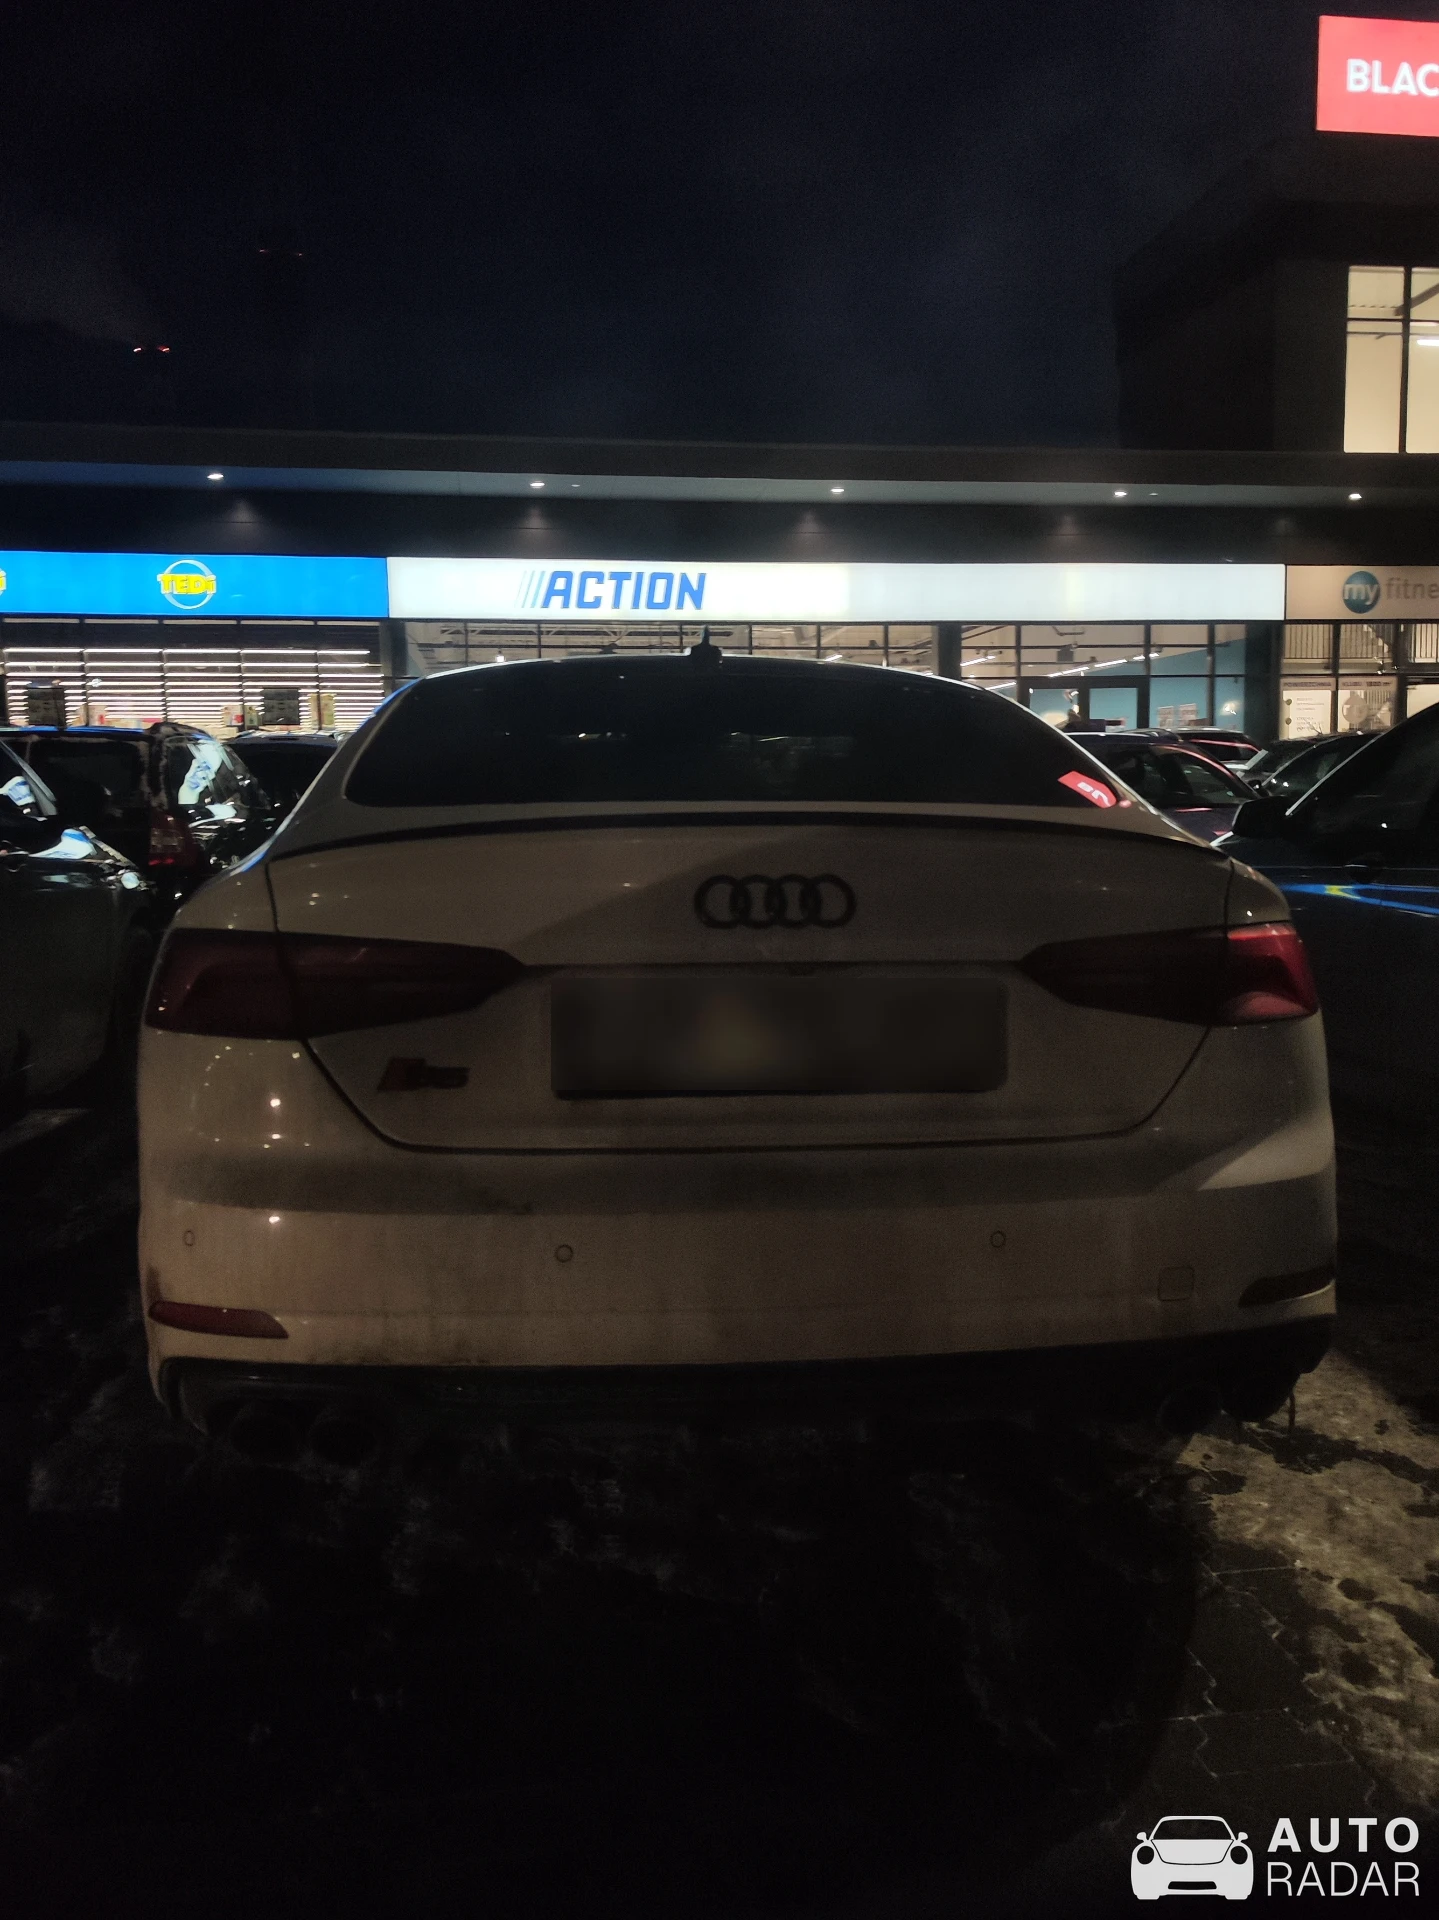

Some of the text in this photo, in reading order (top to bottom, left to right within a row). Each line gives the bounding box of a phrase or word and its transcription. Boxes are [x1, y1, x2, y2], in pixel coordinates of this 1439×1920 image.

[1346, 58, 1439, 97] BLAC
[541, 571, 707, 610] ACTION
[1343, 577, 1439, 605] my fitne
